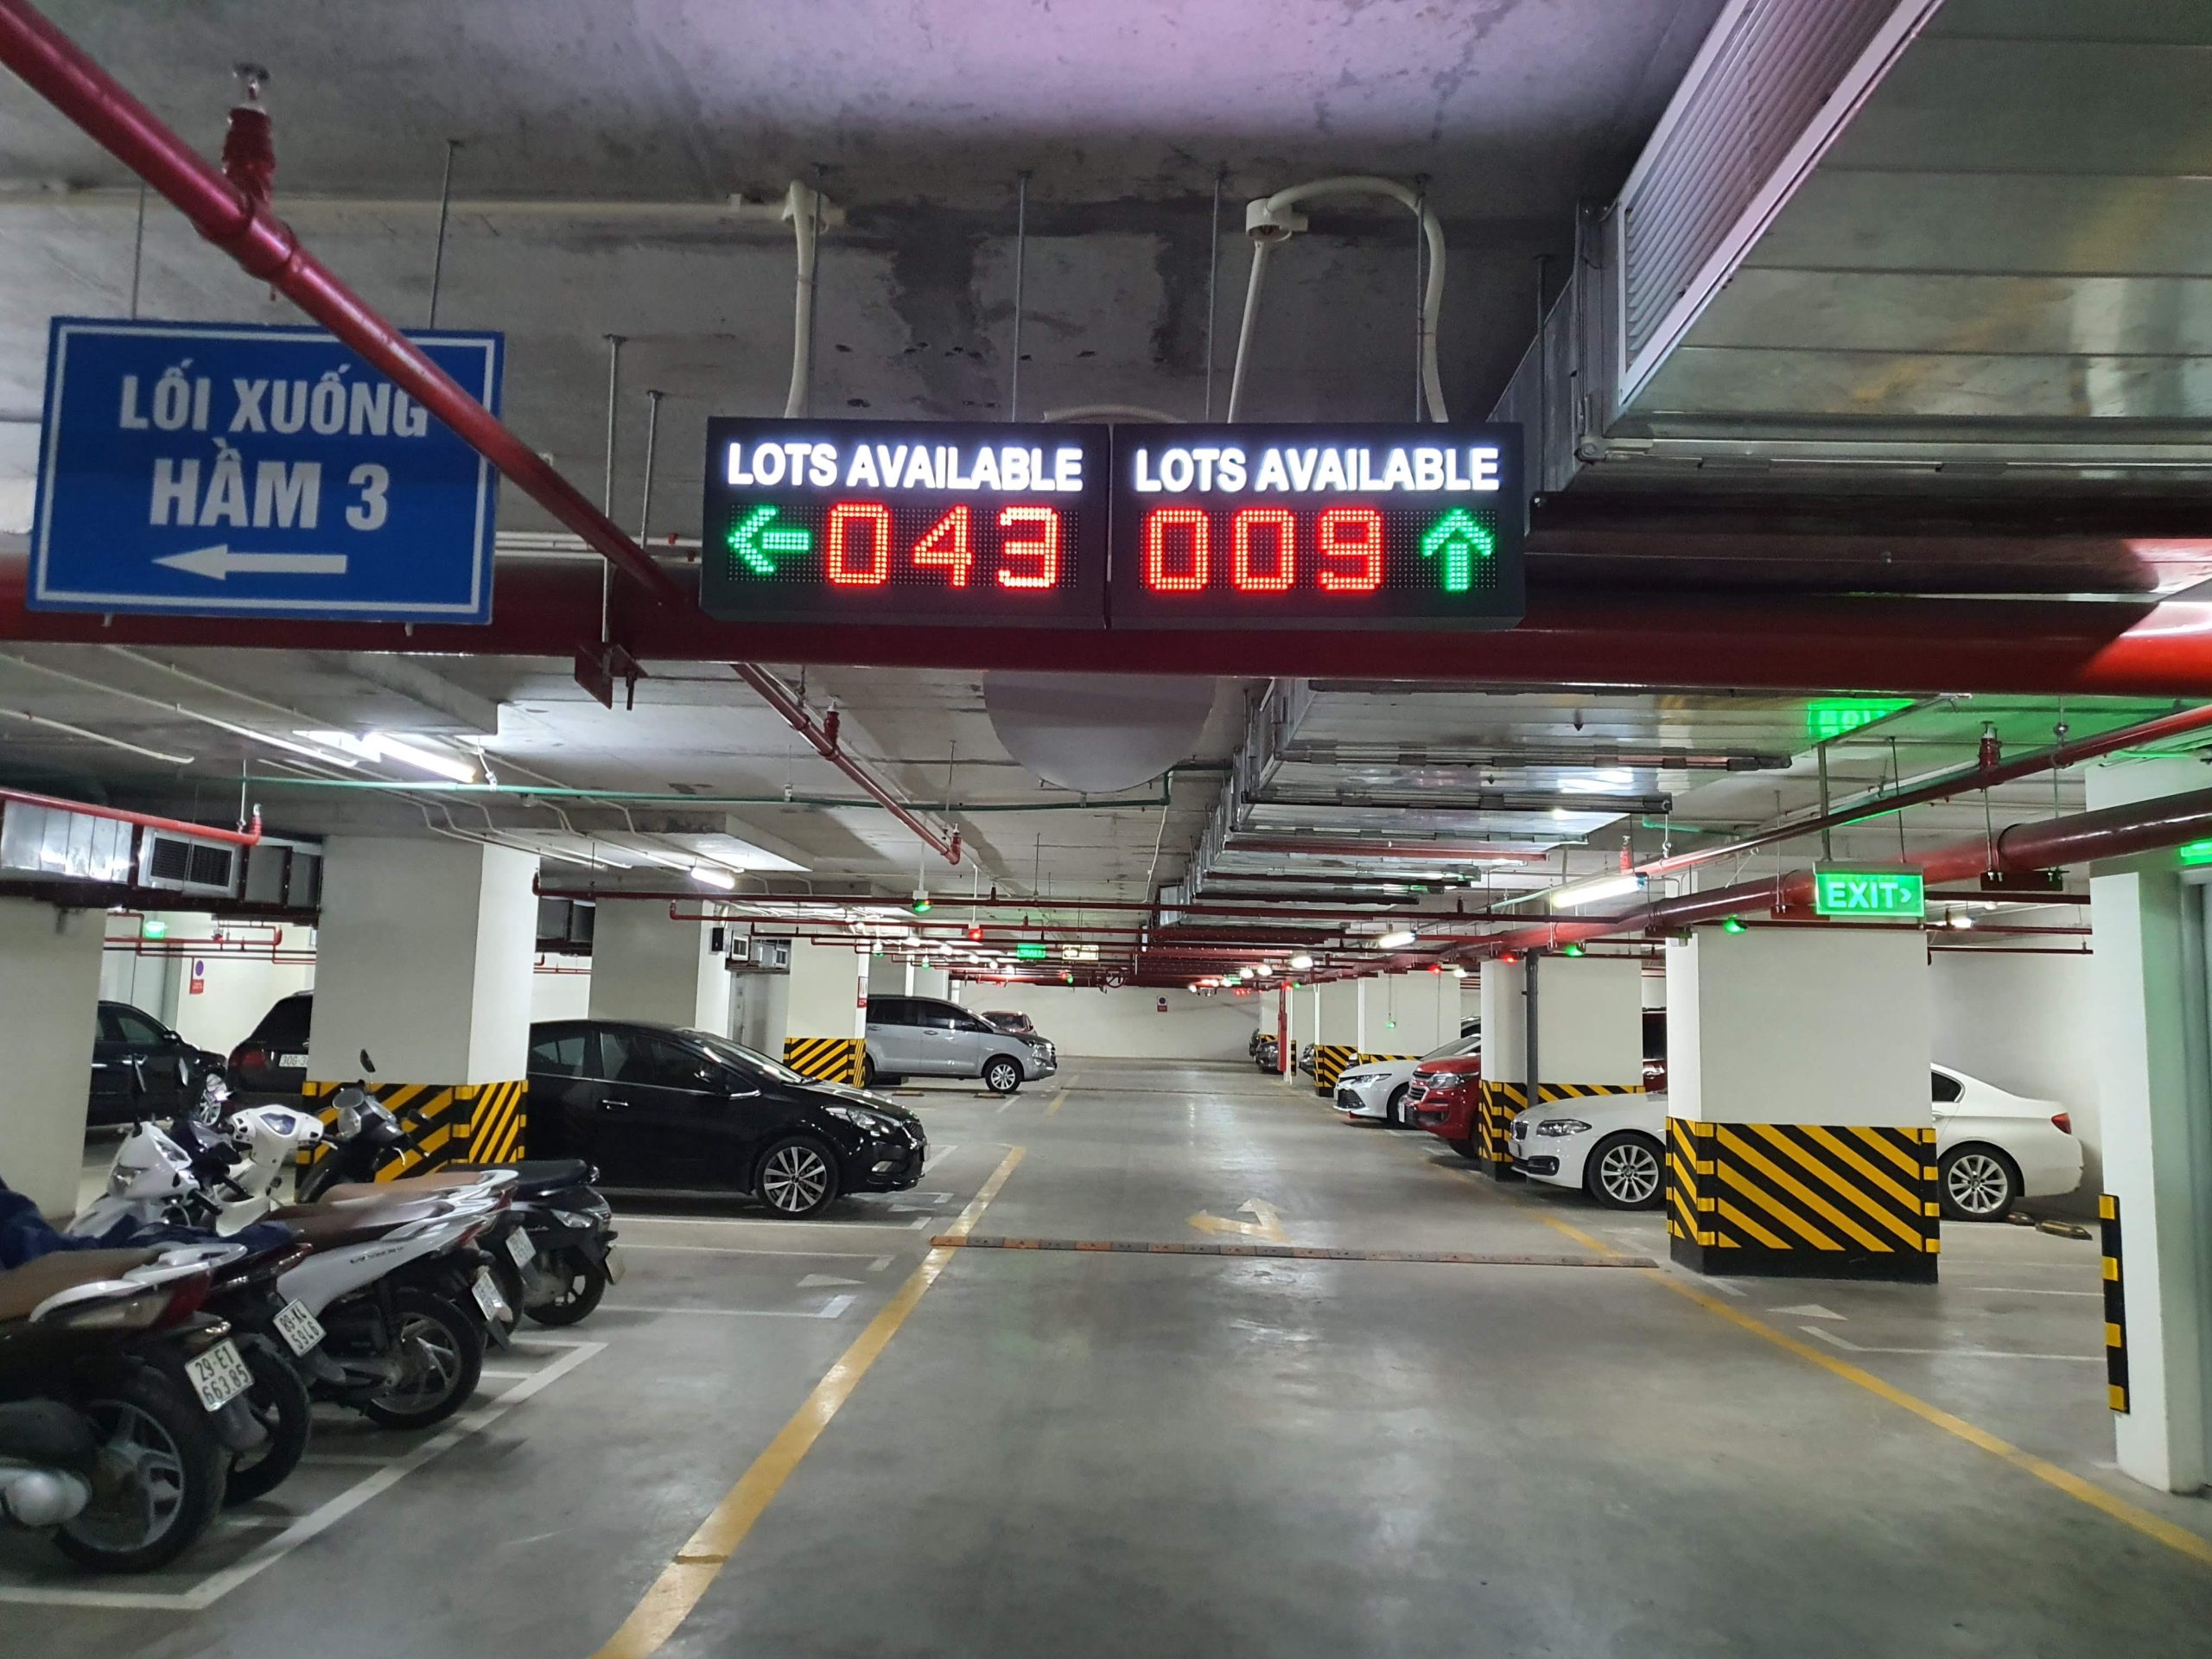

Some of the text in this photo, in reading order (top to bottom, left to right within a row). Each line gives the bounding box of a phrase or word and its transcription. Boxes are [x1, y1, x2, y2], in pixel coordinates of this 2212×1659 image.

[119, 359, 429, 438] LỐI XUỐNG
[149, 436, 390, 531] HẦM 3
[728, 442, 1084, 492] LOTS AVAILABLE
[1135, 447, 1500, 492] LOTS AVAILABLE
[828, 502, 1058, 588] 043
[1147, 508, 1382, 590] 009
[1827, 881, 1899, 909] EXIT
[280, 1055, 308, 1065] 30G-3
